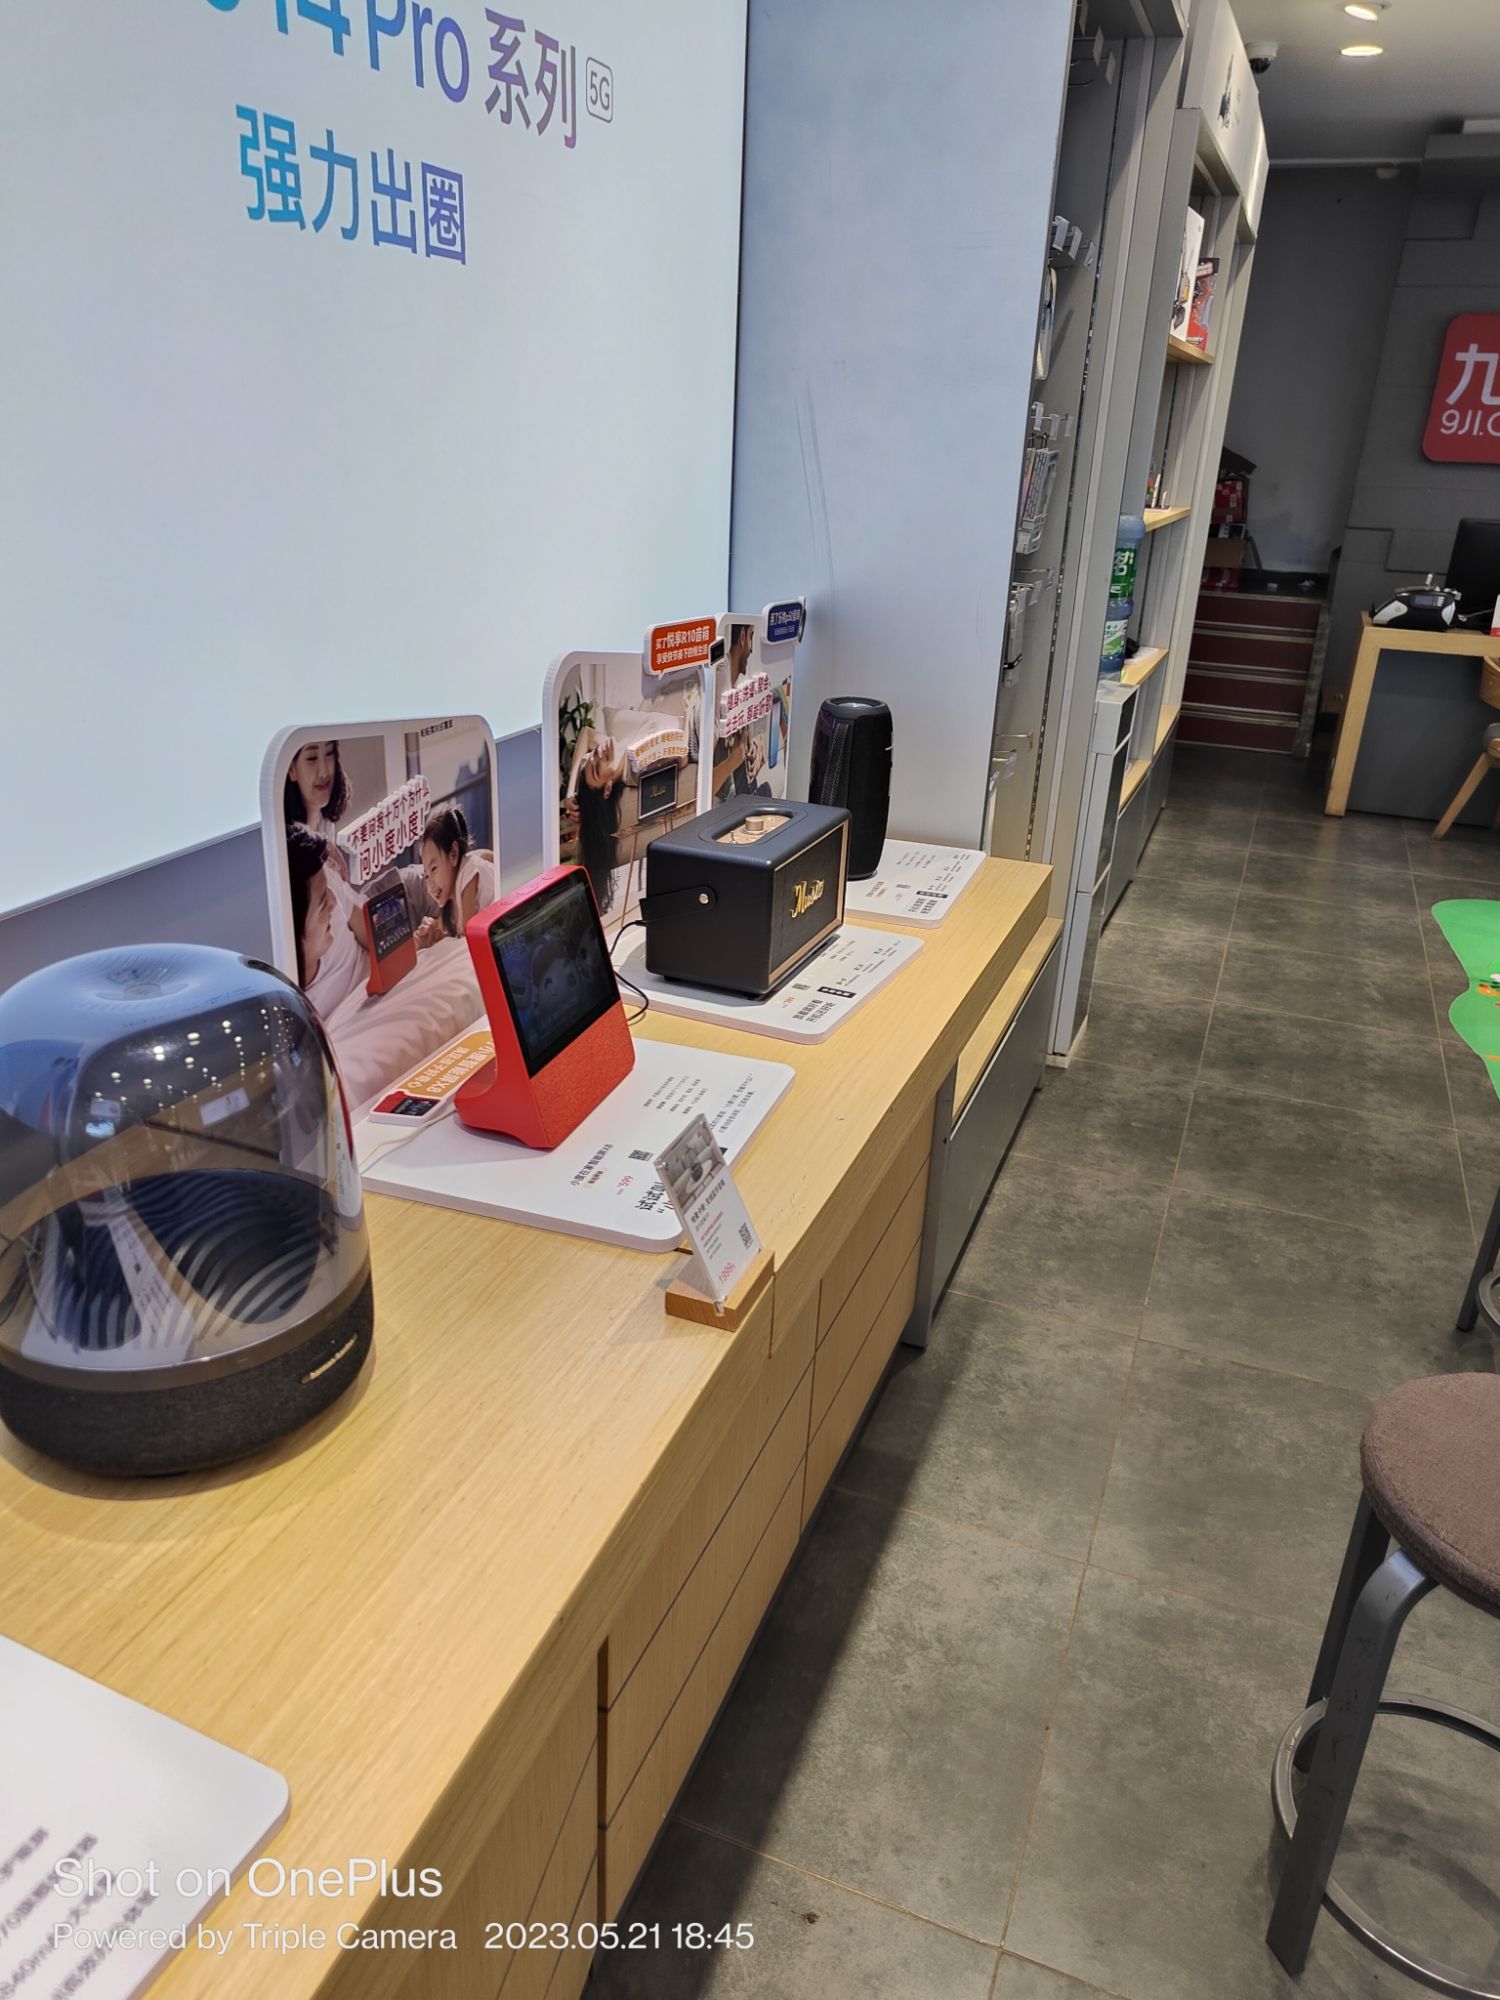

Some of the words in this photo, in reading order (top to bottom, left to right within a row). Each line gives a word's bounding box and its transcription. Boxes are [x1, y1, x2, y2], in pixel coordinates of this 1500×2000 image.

[588, 68, 611, 111] 5G
[235, 104, 467, 265] 强力出圈
